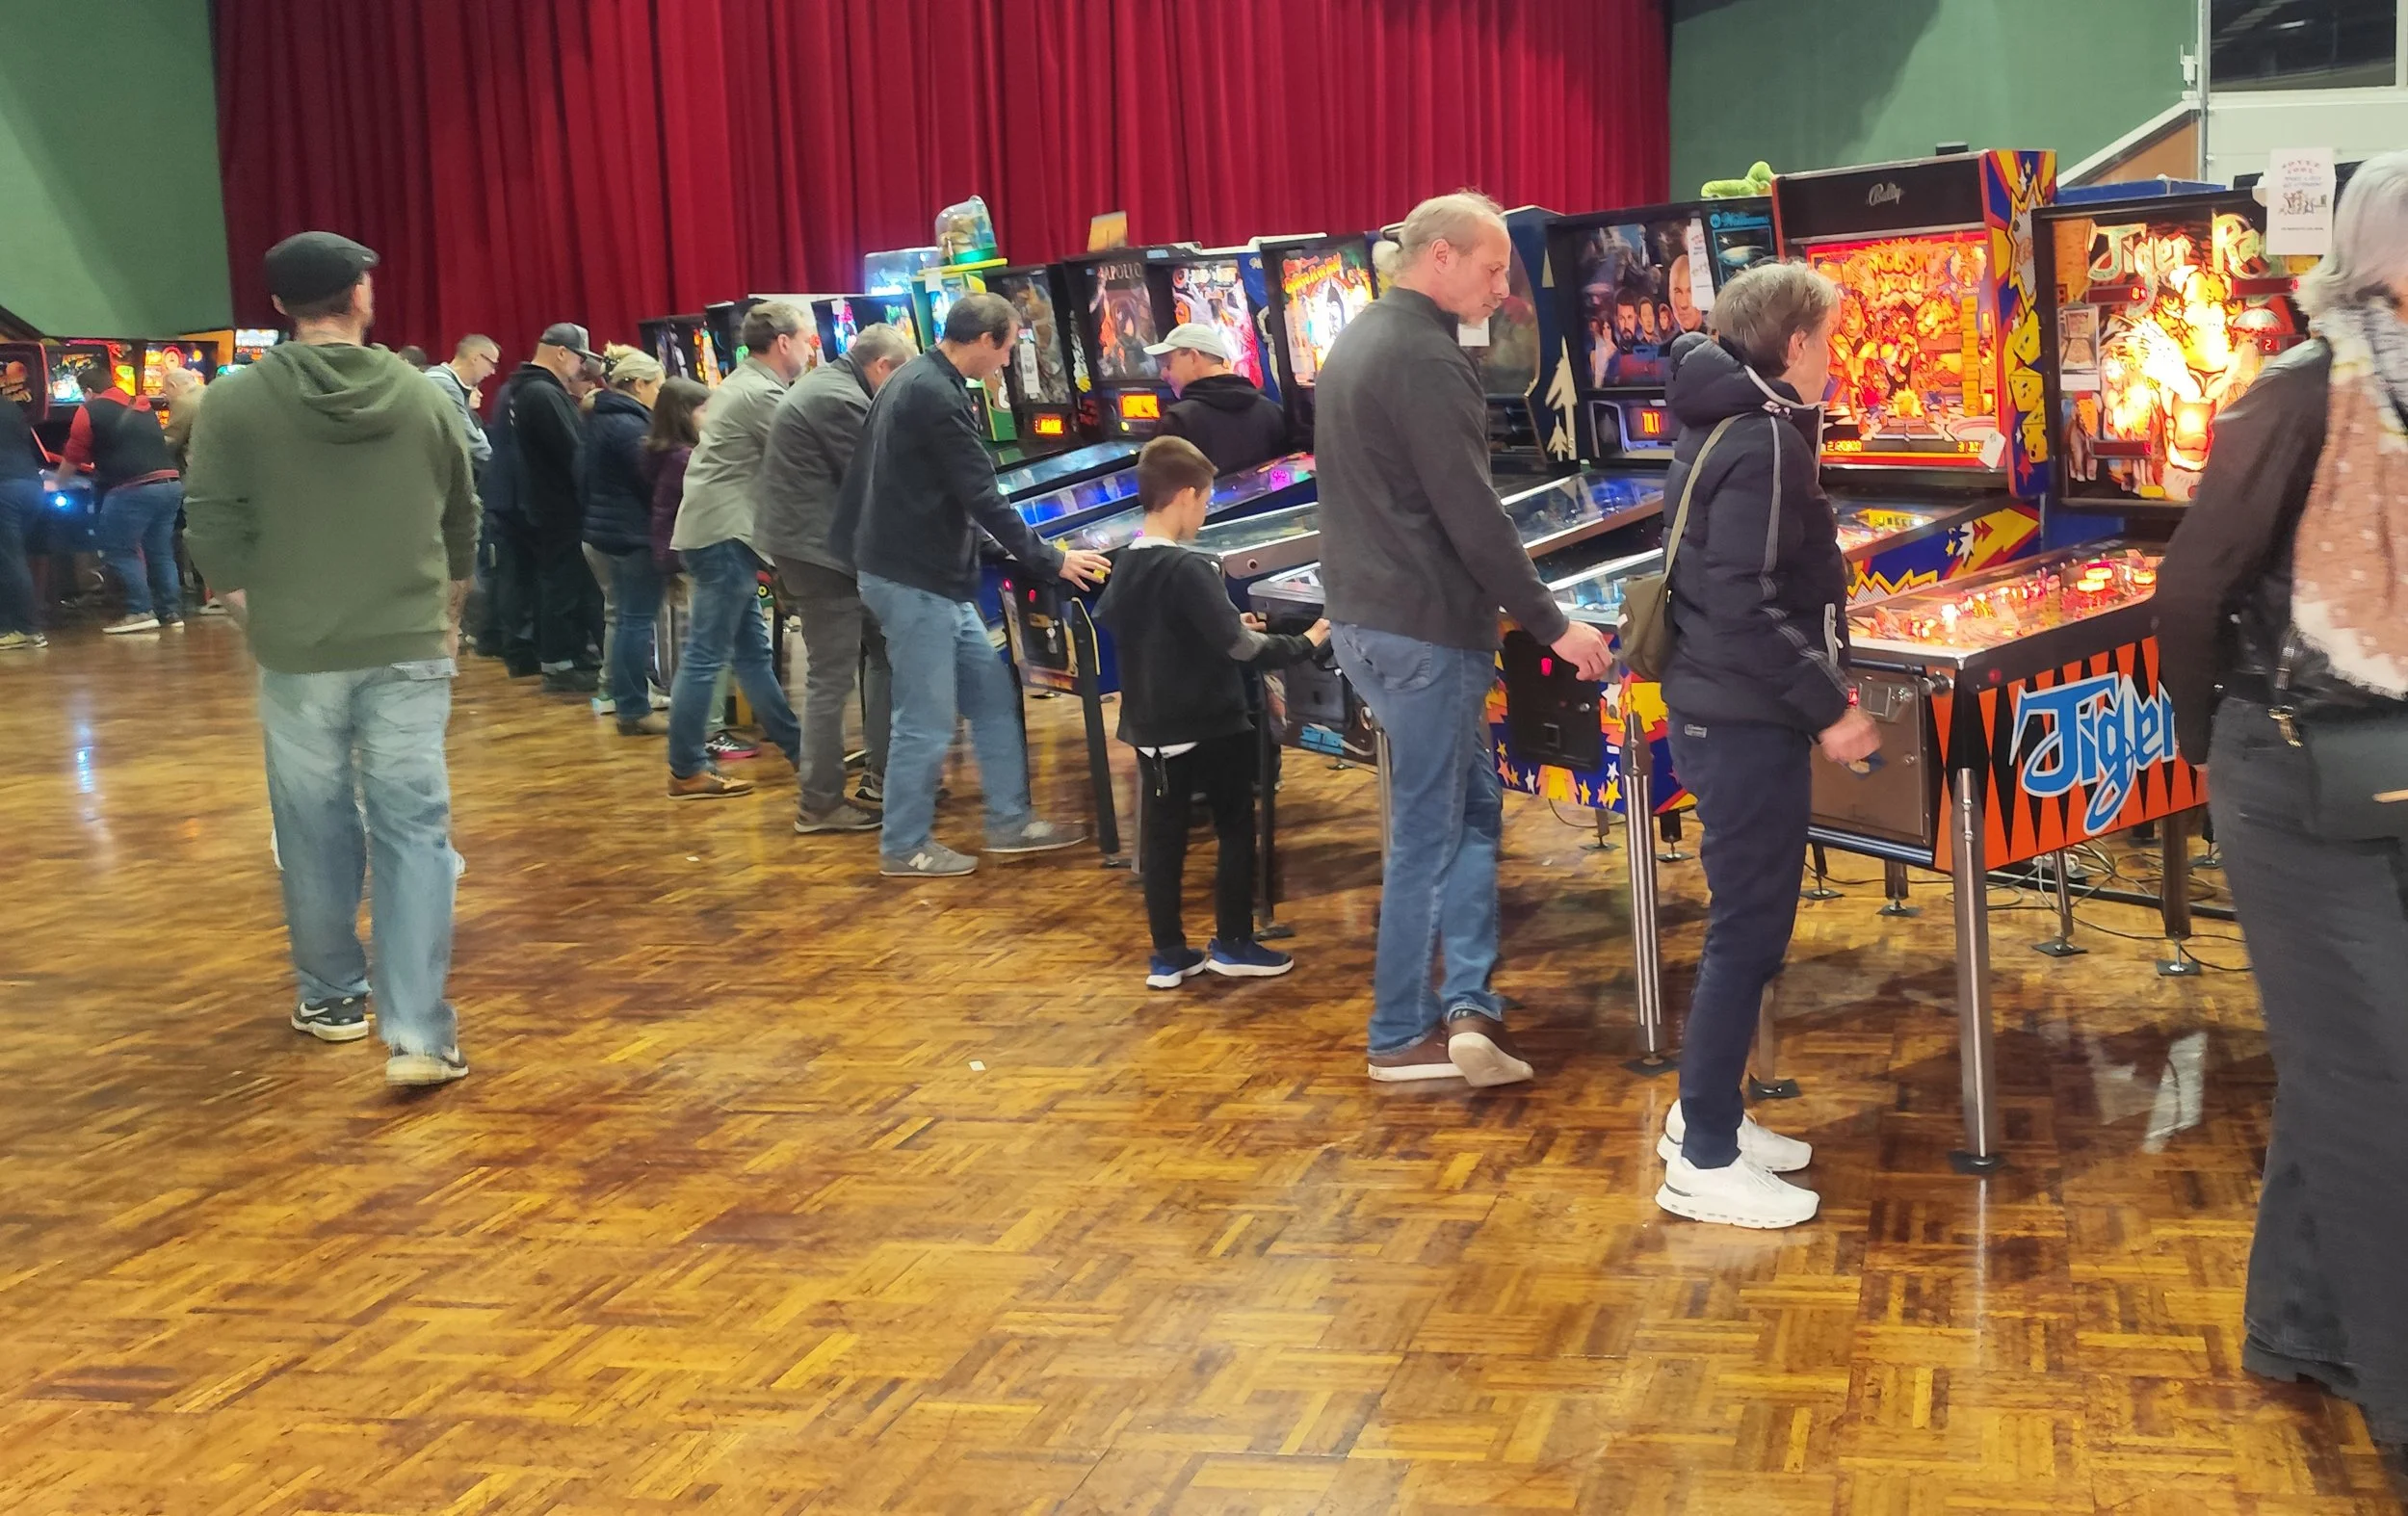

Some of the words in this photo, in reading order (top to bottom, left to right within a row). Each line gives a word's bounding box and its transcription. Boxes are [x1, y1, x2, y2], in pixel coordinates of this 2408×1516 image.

[1869, 182, 1902, 206] Bally
[1104, 262, 1142, 280] APOLLO
[2087, 222, 2192, 319] Tiger
[2008, 670, 2177, 837] Tiger
[907, 852, 934, 871] N
